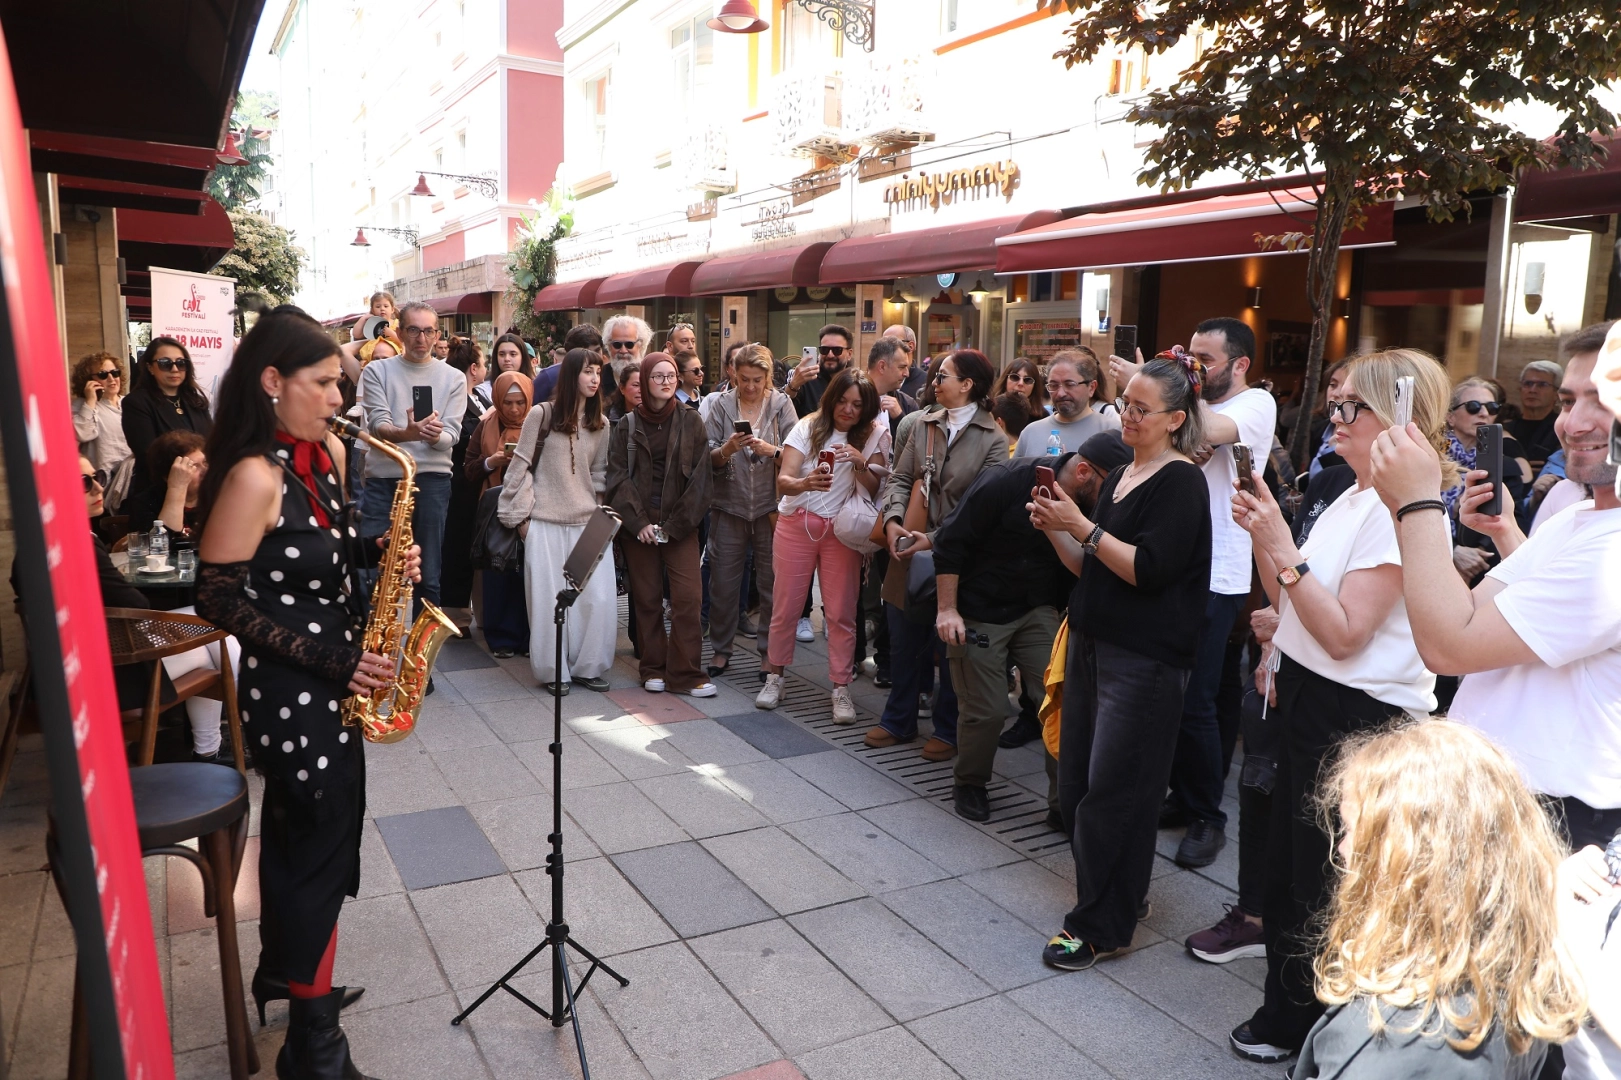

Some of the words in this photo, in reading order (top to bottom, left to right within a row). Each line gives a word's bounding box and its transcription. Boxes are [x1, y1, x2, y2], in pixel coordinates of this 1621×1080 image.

[883, 159, 1018, 206] miniyummy
[183, 299, 200, 312] CAZ
[190, 336, 222, 349] MAYIS
